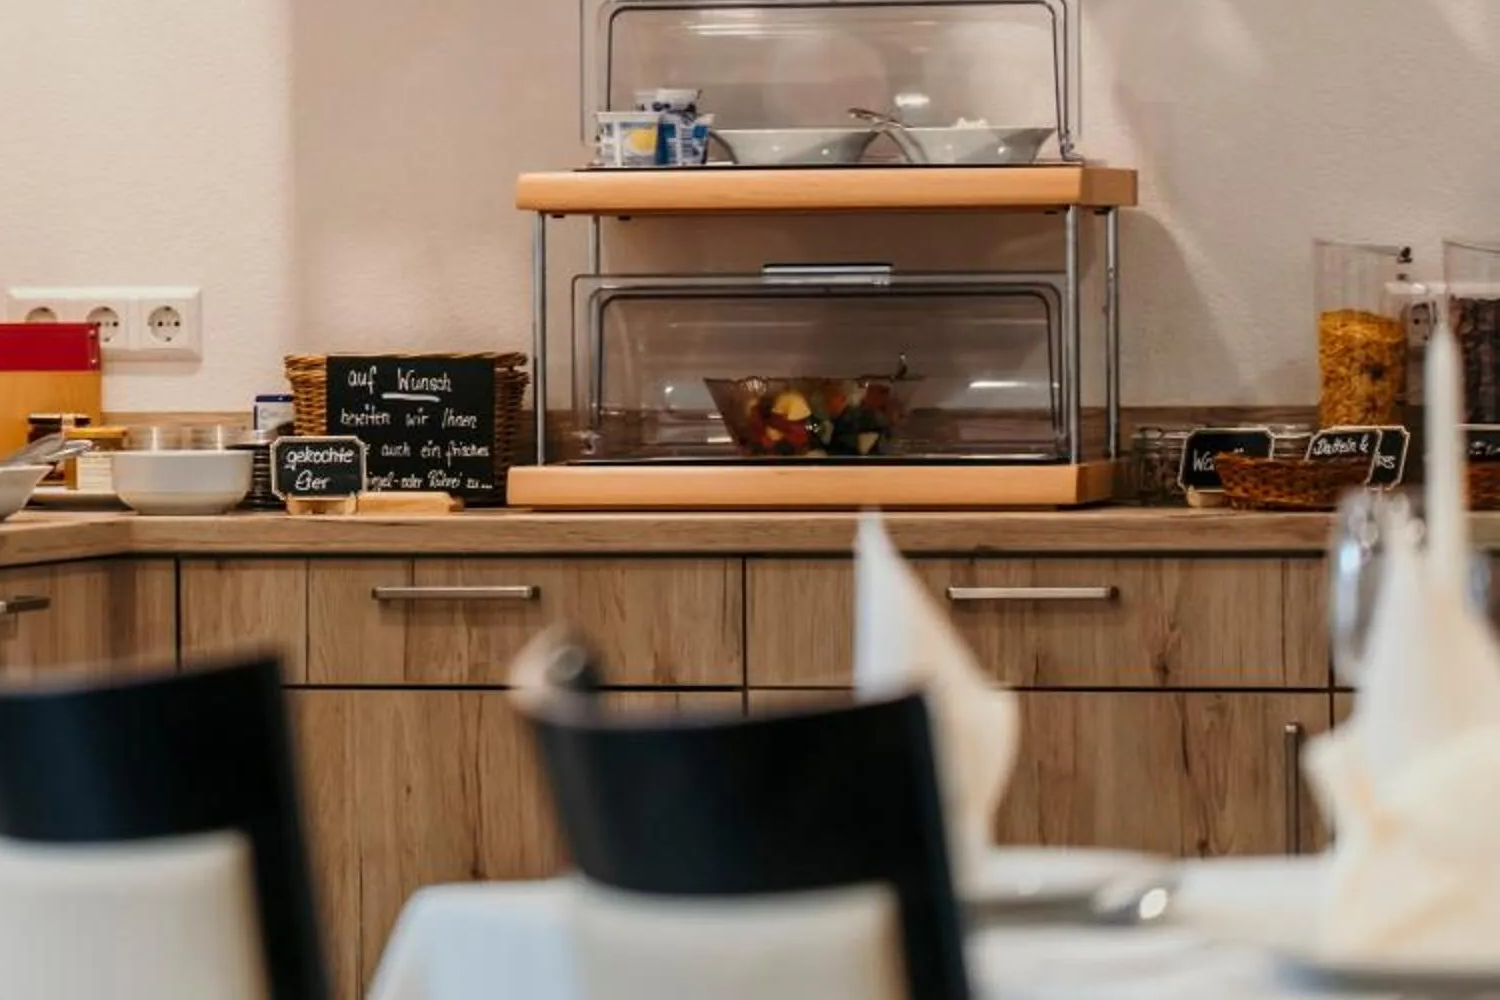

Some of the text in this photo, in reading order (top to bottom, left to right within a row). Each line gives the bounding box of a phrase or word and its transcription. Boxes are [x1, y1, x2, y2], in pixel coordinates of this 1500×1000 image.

[348, 365, 452, 394] auf Wunsch
[405, 407, 429, 427] wir
[284, 446, 354, 471] gekochte
[420, 440, 441, 458] ein
